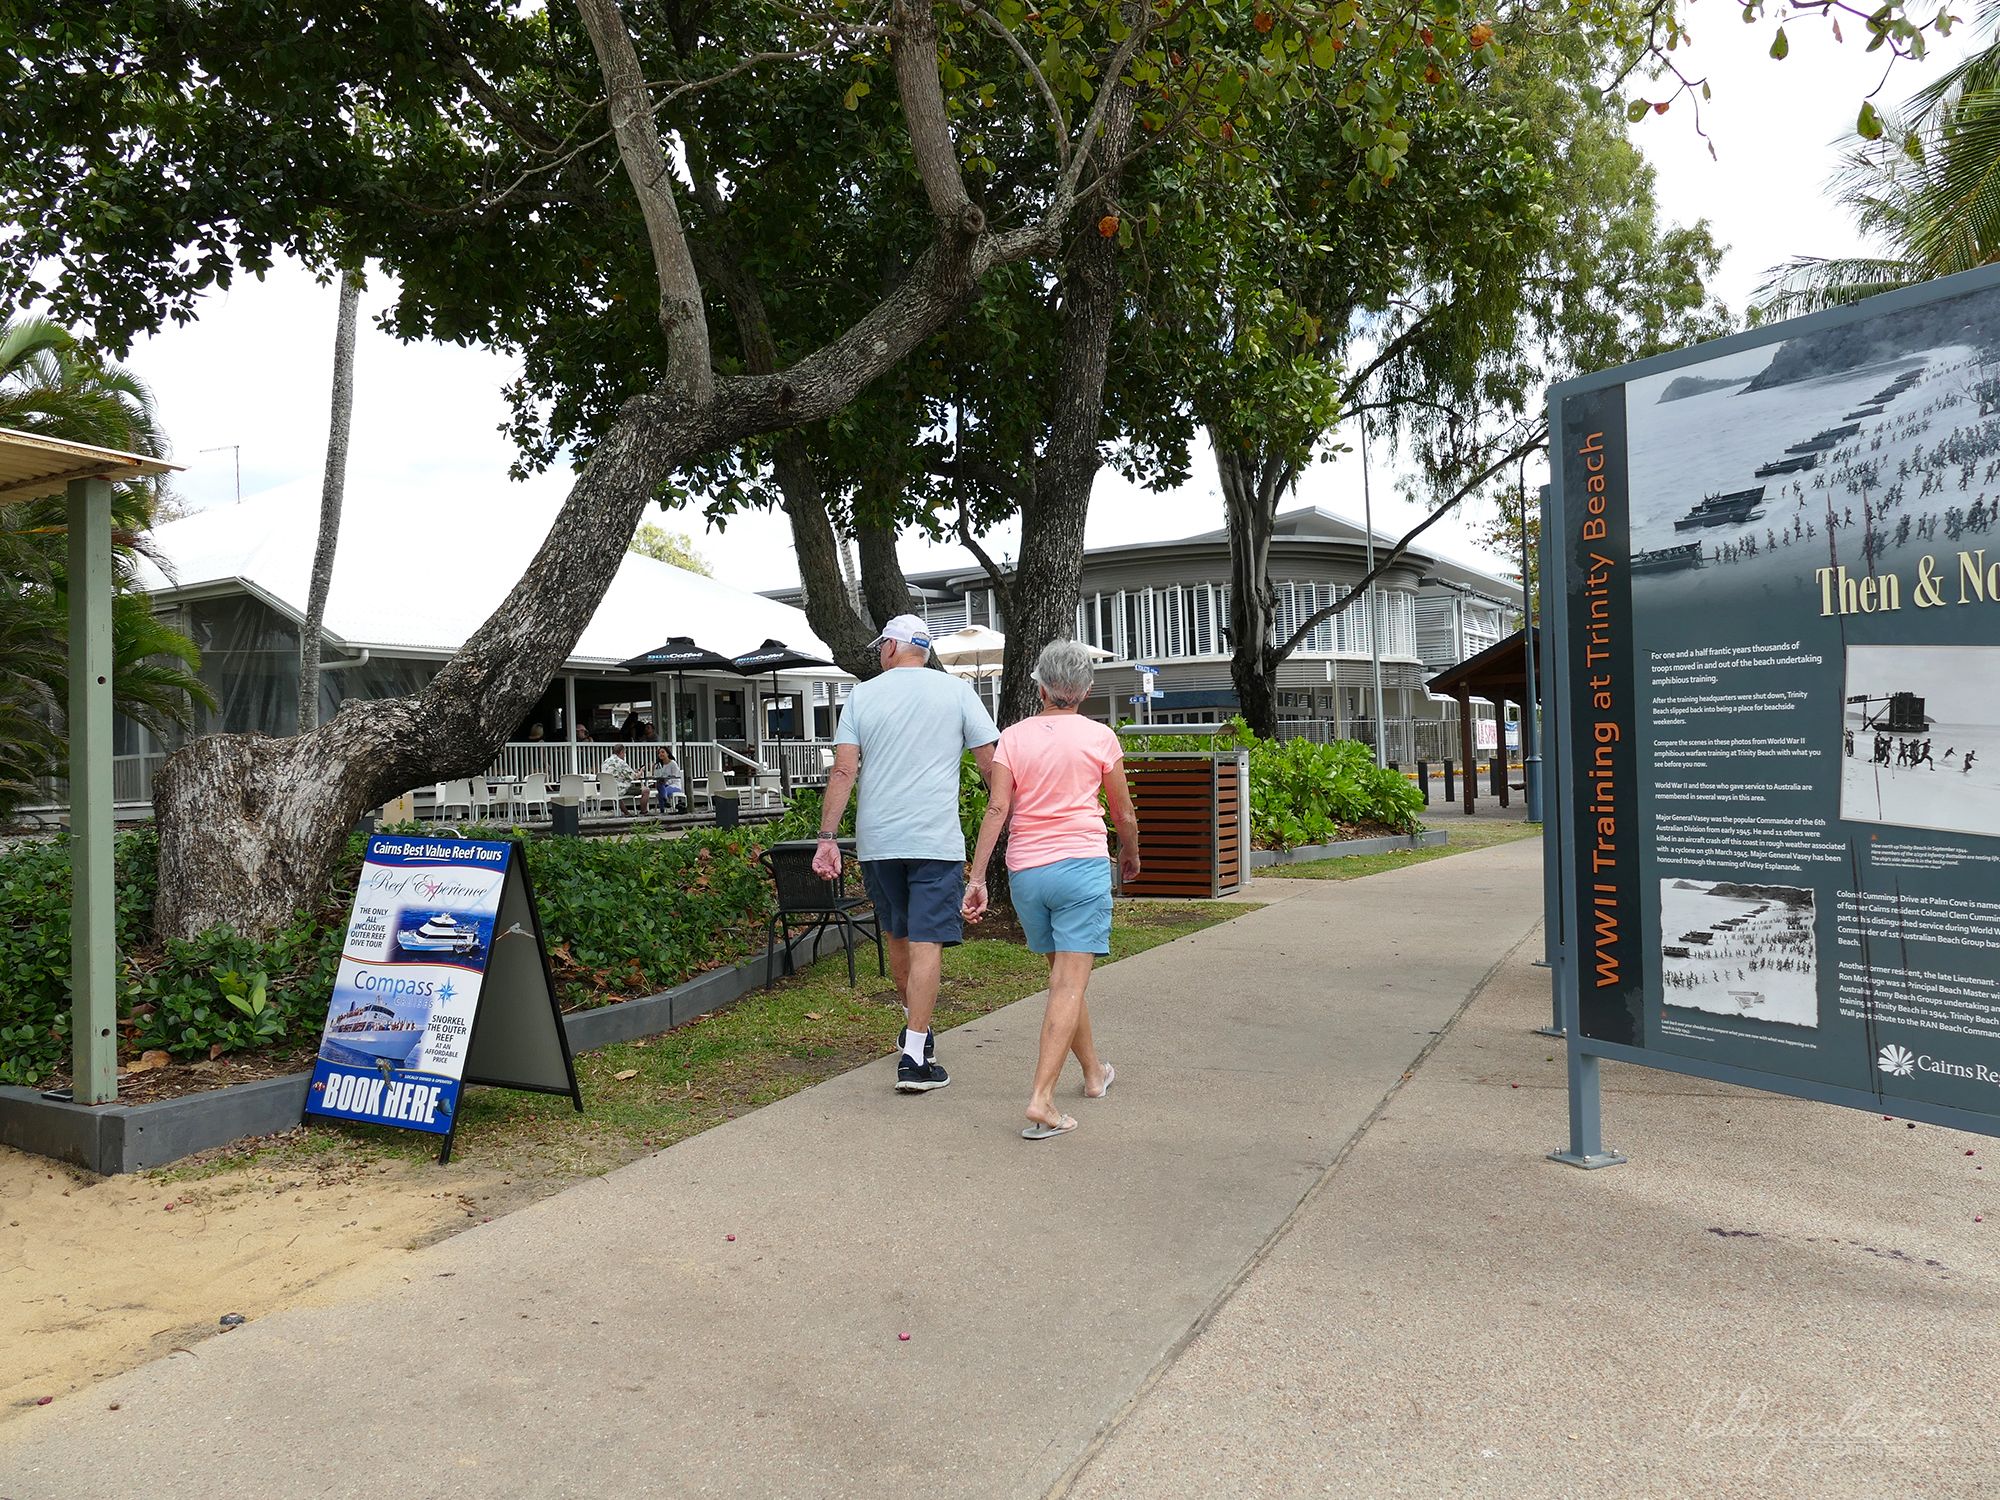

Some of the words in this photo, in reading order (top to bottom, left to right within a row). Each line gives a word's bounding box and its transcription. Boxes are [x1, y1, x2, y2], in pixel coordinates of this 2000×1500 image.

[1580, 432, 1607, 541] Beach
[1816, 566, 1901, 616] Then
[1914, 555, 1946, 608] &
[1585, 552, 1616, 668] Trinity
[1676, 650, 1689, 658] and
[1695, 648, 1709, 657] half
[1709, 647, 1732, 656] frantic
[1732, 647, 1752, 656] years
[1752, 642, 1791, 652] thousands
[1792, 641, 1800, 650] of
[1673, 662, 1696, 671] moved
[1704, 661, 1718, 669] and
[1732, 659, 1740, 668] of
[1740, 659, 1753, 667] the
[1754, 657, 1776, 666] beach
[1776, 655, 1823, 665] undertaking
[1652, 676, 1690, 686] amphibious
[1690, 675, 1719, 684] training.
[1590, 674, 1612, 710] at
[1731, 738, 1752, 747] photos
[1589, 722, 1619, 873] Training
[1656, 814, 1672, 822] Major
[1693, 815, 1711, 823] Vasey
[1721, 827, 1736, 835] early
[374, 842, 402, 855] Cairns
[403, 843, 424, 856] Best
[425, 844, 452, 858] Value
[452, 846, 476, 859] Reef
[476, 847, 502, 861] Tours
[1683, 858, 1706, 867] through
[1717, 860, 1739, 869] naming
[1746, 862, 1765, 870] Vasey
[370, 869, 411, 898] Reef
[1900, 895, 1920, 904] Drive
[1929, 897, 1949, 906] Palm
[1949, 899, 1968, 907] Cove
[1969, 900, 1976, 908] is
[1869, 905, 1890, 913] Cairns
[1921, 909, 1948, 918] Colonel
[1949, 912, 1968, 920] Clem
[355, 923, 386, 932] INCLUSIVE
[1919, 922, 1944, 930] service
[1945, 924, 1970, 935] during
[1970, 926, 1993, 935] World
[1594, 884, 1619, 988] WWII
[1838, 938, 1861, 946] Beach.
[1938, 936, 1961, 944] Beach
[1961, 938, 1985, 948] Group
[355, 971, 433, 998] Compass
[1924, 971, 1937, 980] the
[1938, 973, 1952, 981] late
[1953, 975, 1995, 986] Lieutenant
[1939, 986, 1962, 995] Beach
[1963, 989, 1990, 998] Master
[1874, 990, 1893, 1000] Army
[1894, 992, 1916, 1001] Beach
[1917, 995, 1943, 1006] Groups
[1944, 1000, 1990, 1013] undertaking
[432, 1015, 465, 1026] SNORKEL
[1840, 1009, 1855, 1017] Wall
[1907, 1018, 1919, 1027] the
[1920, 1020, 1938, 1029] RAN
[1940, 1023, 1962, 1032] Beach
[1874, 1001, 1897, 1012] Trinity
[1929, 1011, 1950, 1019] 1944.
[1950, 1012, 1975, 1023] Trinity
[1976, 1015, 2000, 1025] Beach
[428, 1023, 441, 1031] THE
[442, 1025, 467, 1034] OUTER
[436, 1033, 454, 1042] REEF
[425, 1049, 458, 1058] AFFORDABLE
[1918, 1055, 1973, 1078] Cairns
[1976, 1064, 2000, 1087] Re
[322, 1073, 385, 1115] BOOK
[382, 1081, 441, 1124] HERE
